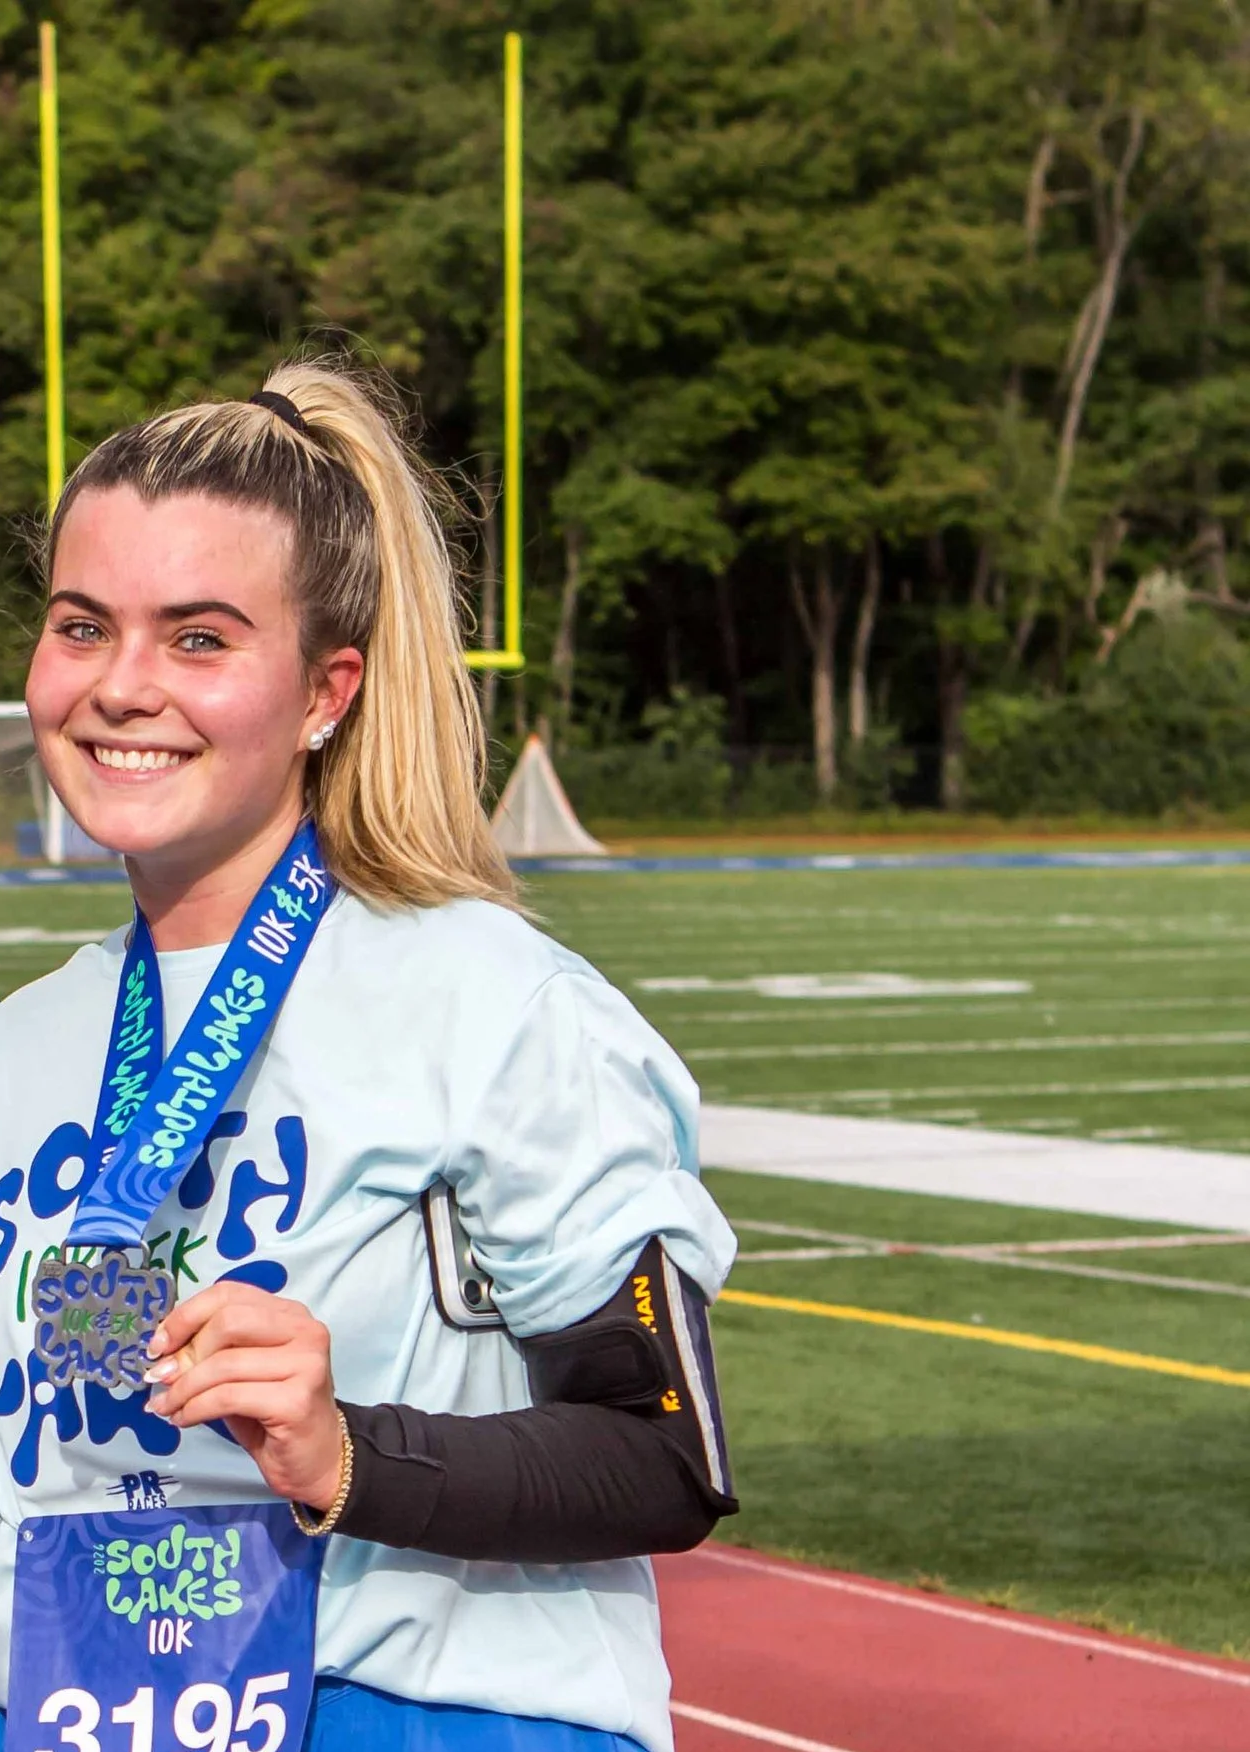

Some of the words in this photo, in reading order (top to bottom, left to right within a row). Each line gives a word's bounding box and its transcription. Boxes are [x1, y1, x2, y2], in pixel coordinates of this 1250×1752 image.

[116, 959, 154, 1051] SOUTH
[139, 1065, 217, 1168] SOUTH
[186, 967, 266, 1073] LAKES
[247, 908, 297, 965] 10K
[287, 853, 327, 904] 5K
[36, 1258, 168, 1322] SOUTH
[119, 1470, 163, 1500] PR
[93, 1542, 105, 1575] 2026
[106, 1523, 241, 1579] SOUTH
[106, 1569, 243, 1624] LAKES
[148, 1619, 194, 1656] 10K
